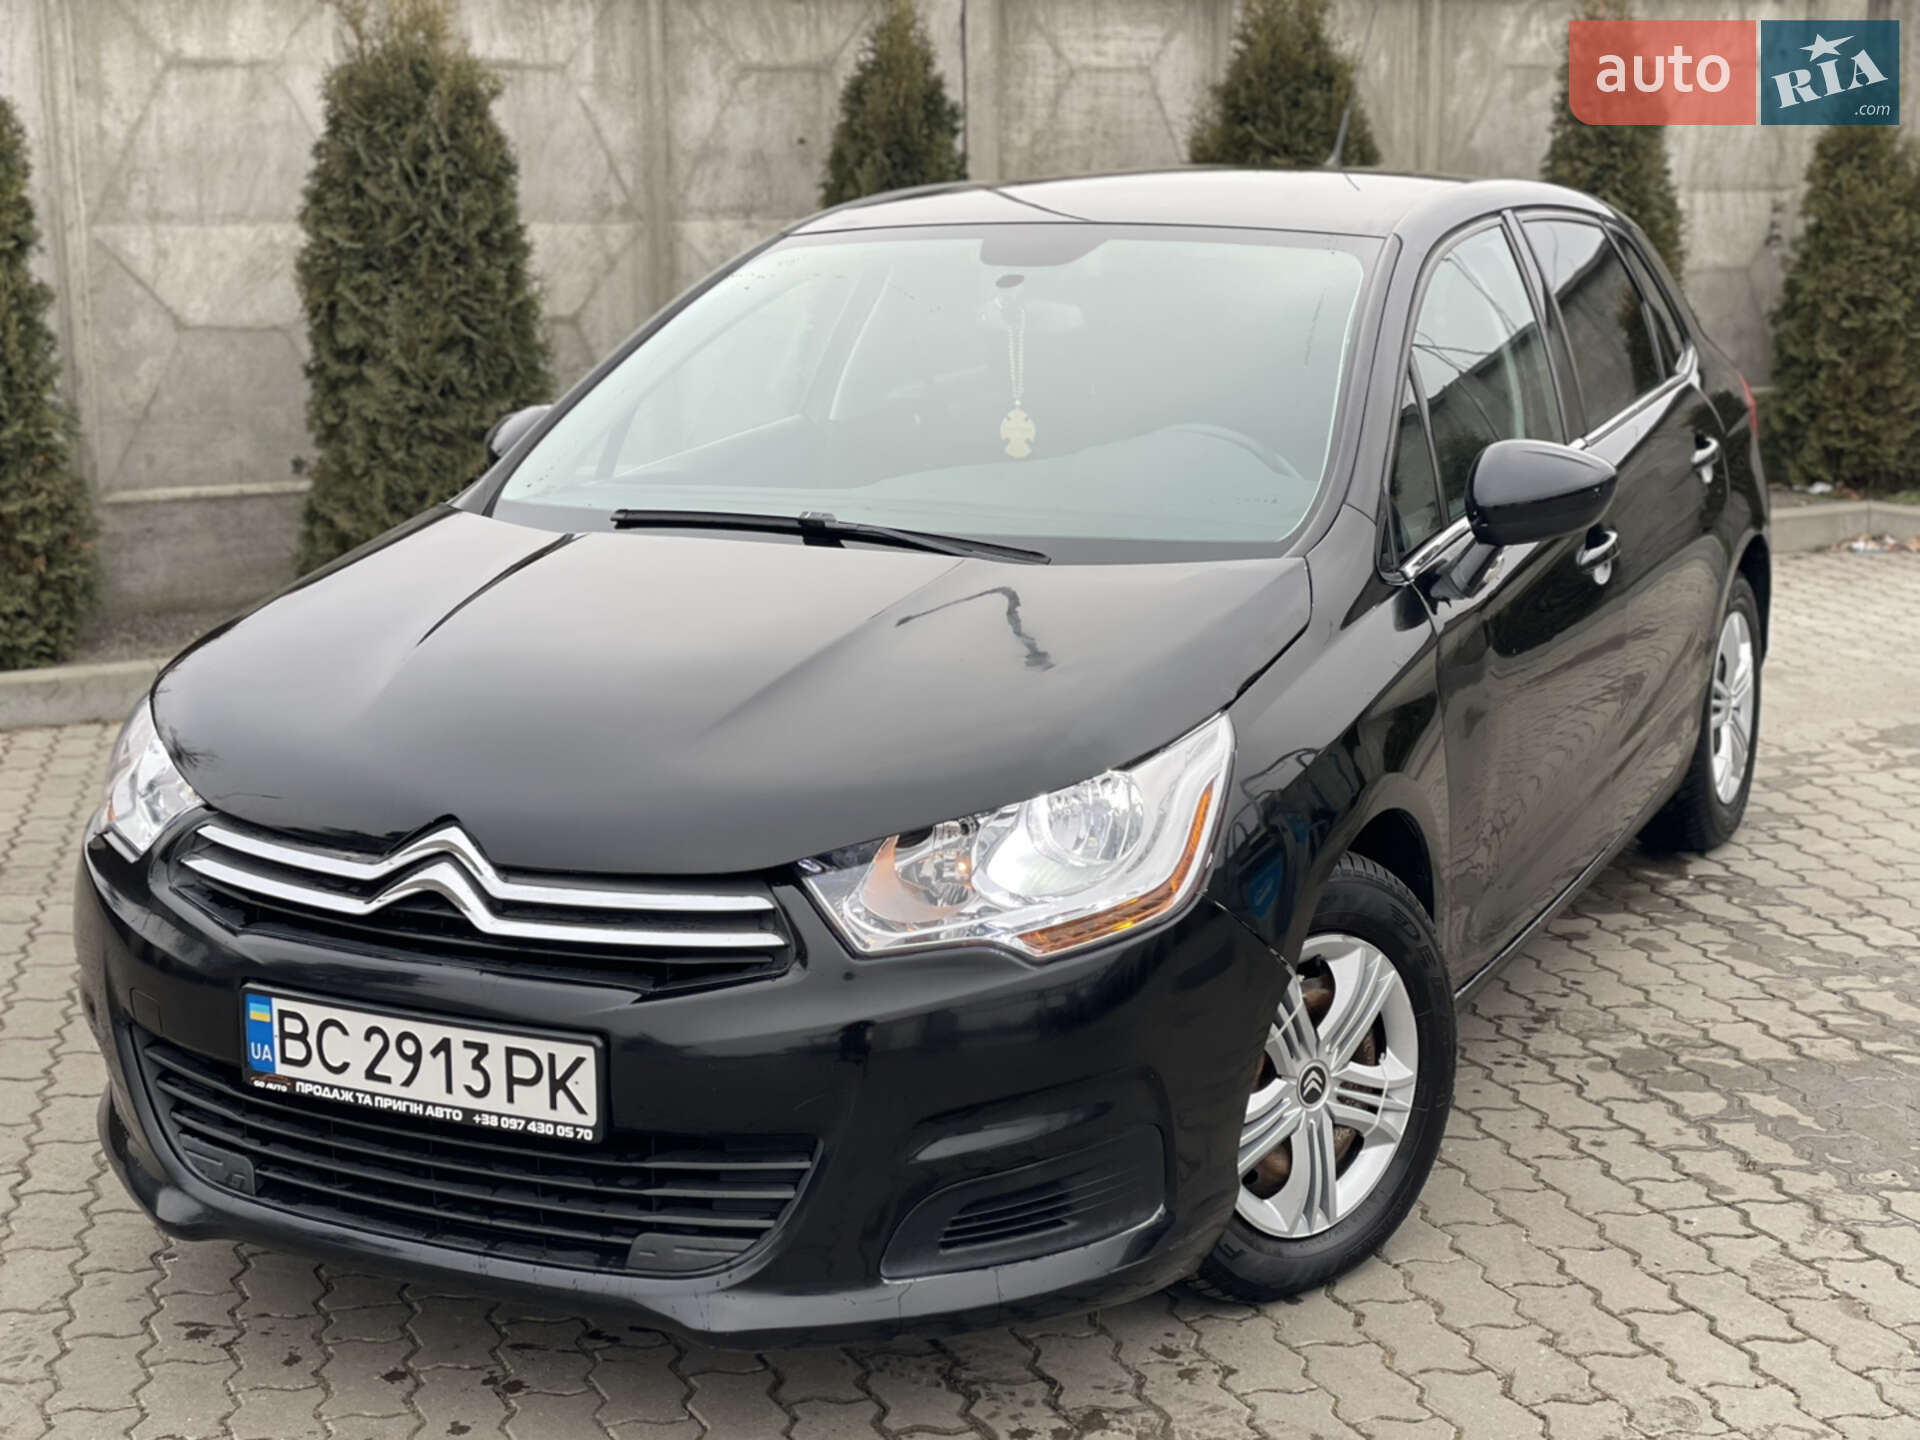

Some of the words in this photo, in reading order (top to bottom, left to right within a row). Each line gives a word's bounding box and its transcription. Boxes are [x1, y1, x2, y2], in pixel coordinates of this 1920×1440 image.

[250, 1042, 273, 1063] UA
[277, 1008, 350, 1075] BC
[364, 1025, 492, 1099] 2913
[504, 1046, 588, 1116] PK
[295, 1081, 354, 1103] ПРОДАЖ
[355, 1093, 373, 1107] ТА
[374, 1096, 424, 1116] ПРИГІН
[425, 1103, 463, 1121] АВТО
[473, 1113, 499, 1127] +38
[500, 1116, 525, 1131] 097
[527, 1121, 555, 1135] 430
[556, 1125, 574, 1139] 05
[576, 1128, 593, 1141] 70
